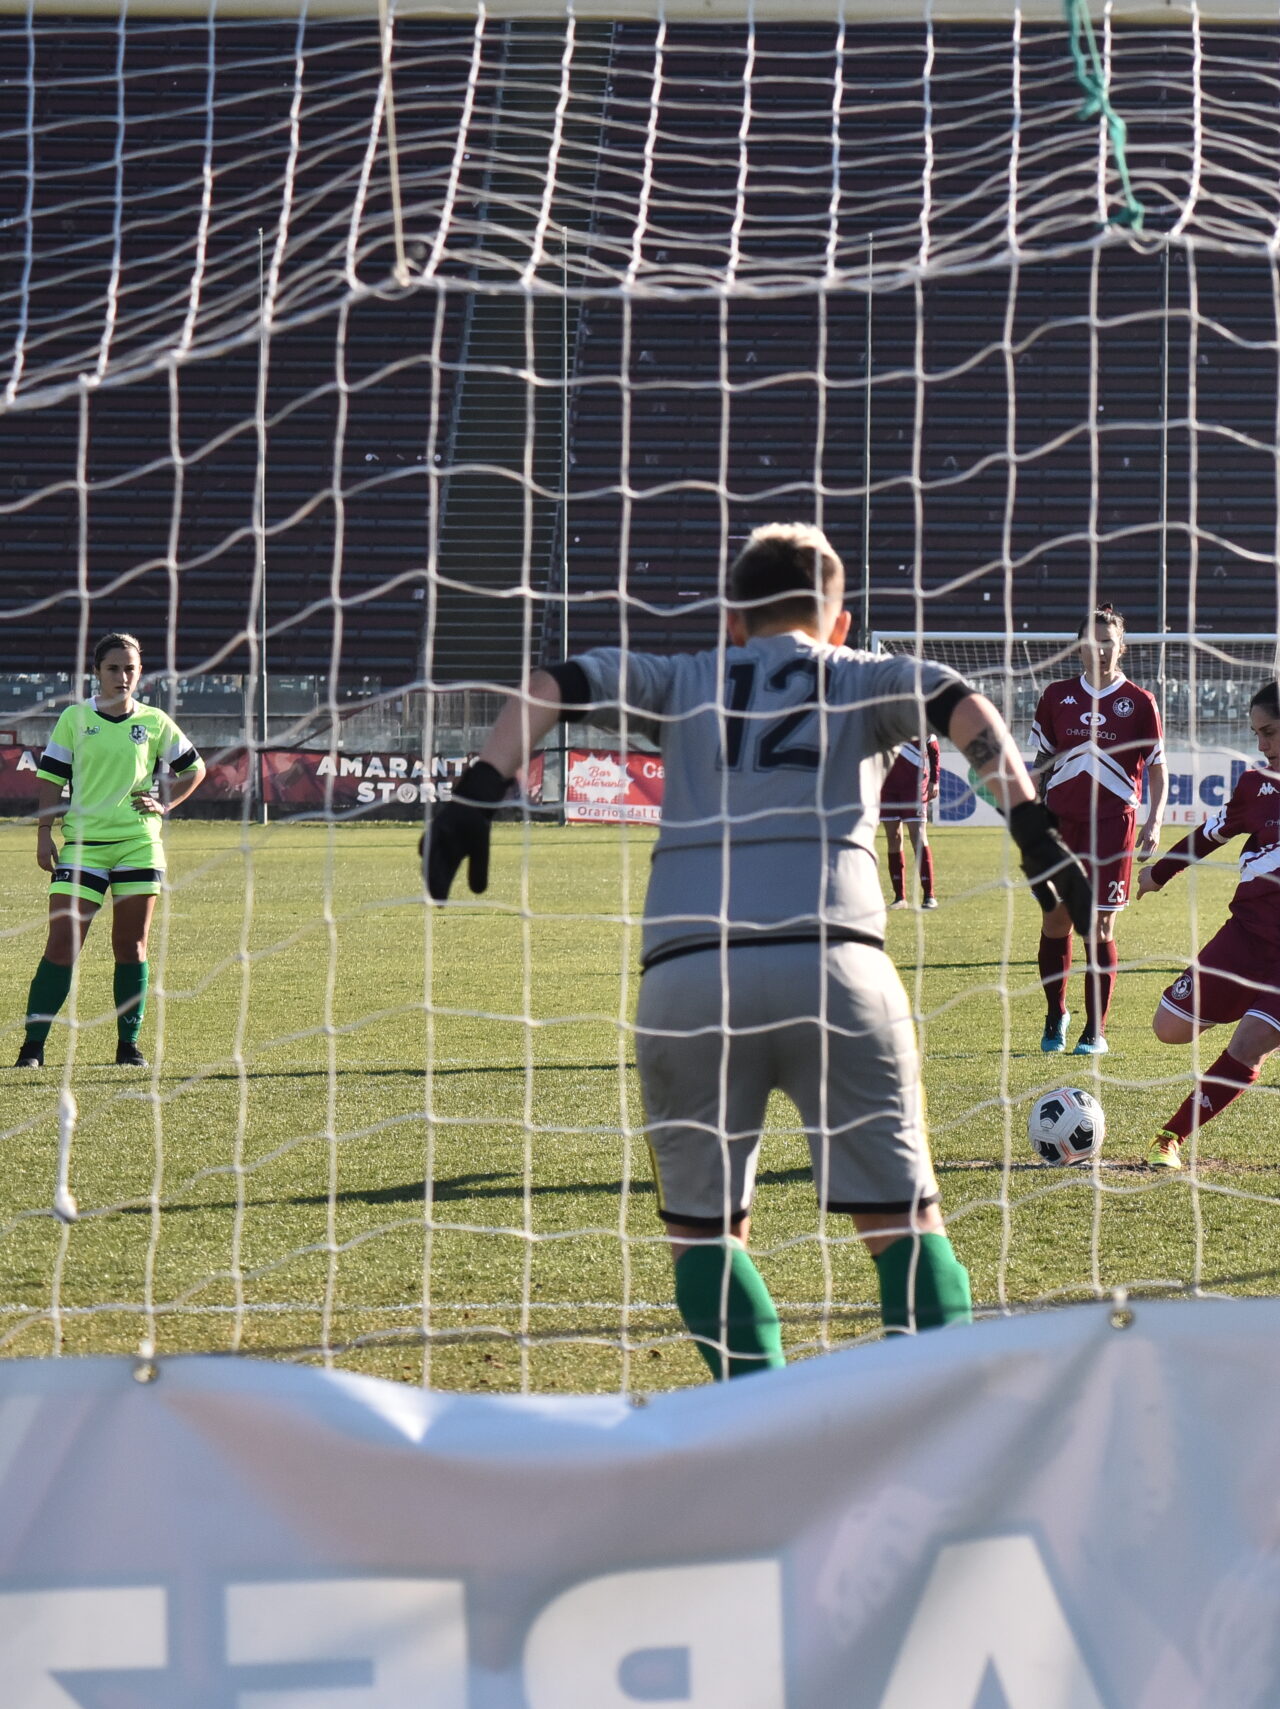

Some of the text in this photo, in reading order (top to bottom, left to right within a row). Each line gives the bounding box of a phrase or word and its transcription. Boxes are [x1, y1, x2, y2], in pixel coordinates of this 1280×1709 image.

[717, 658, 832, 772] 12
[1065, 728, 1117, 741] CHIMERGOLD
[316, 755, 480, 779] AMARANT
[357, 781, 453, 804] STORE
[1107, 880, 1126, 903] 25
